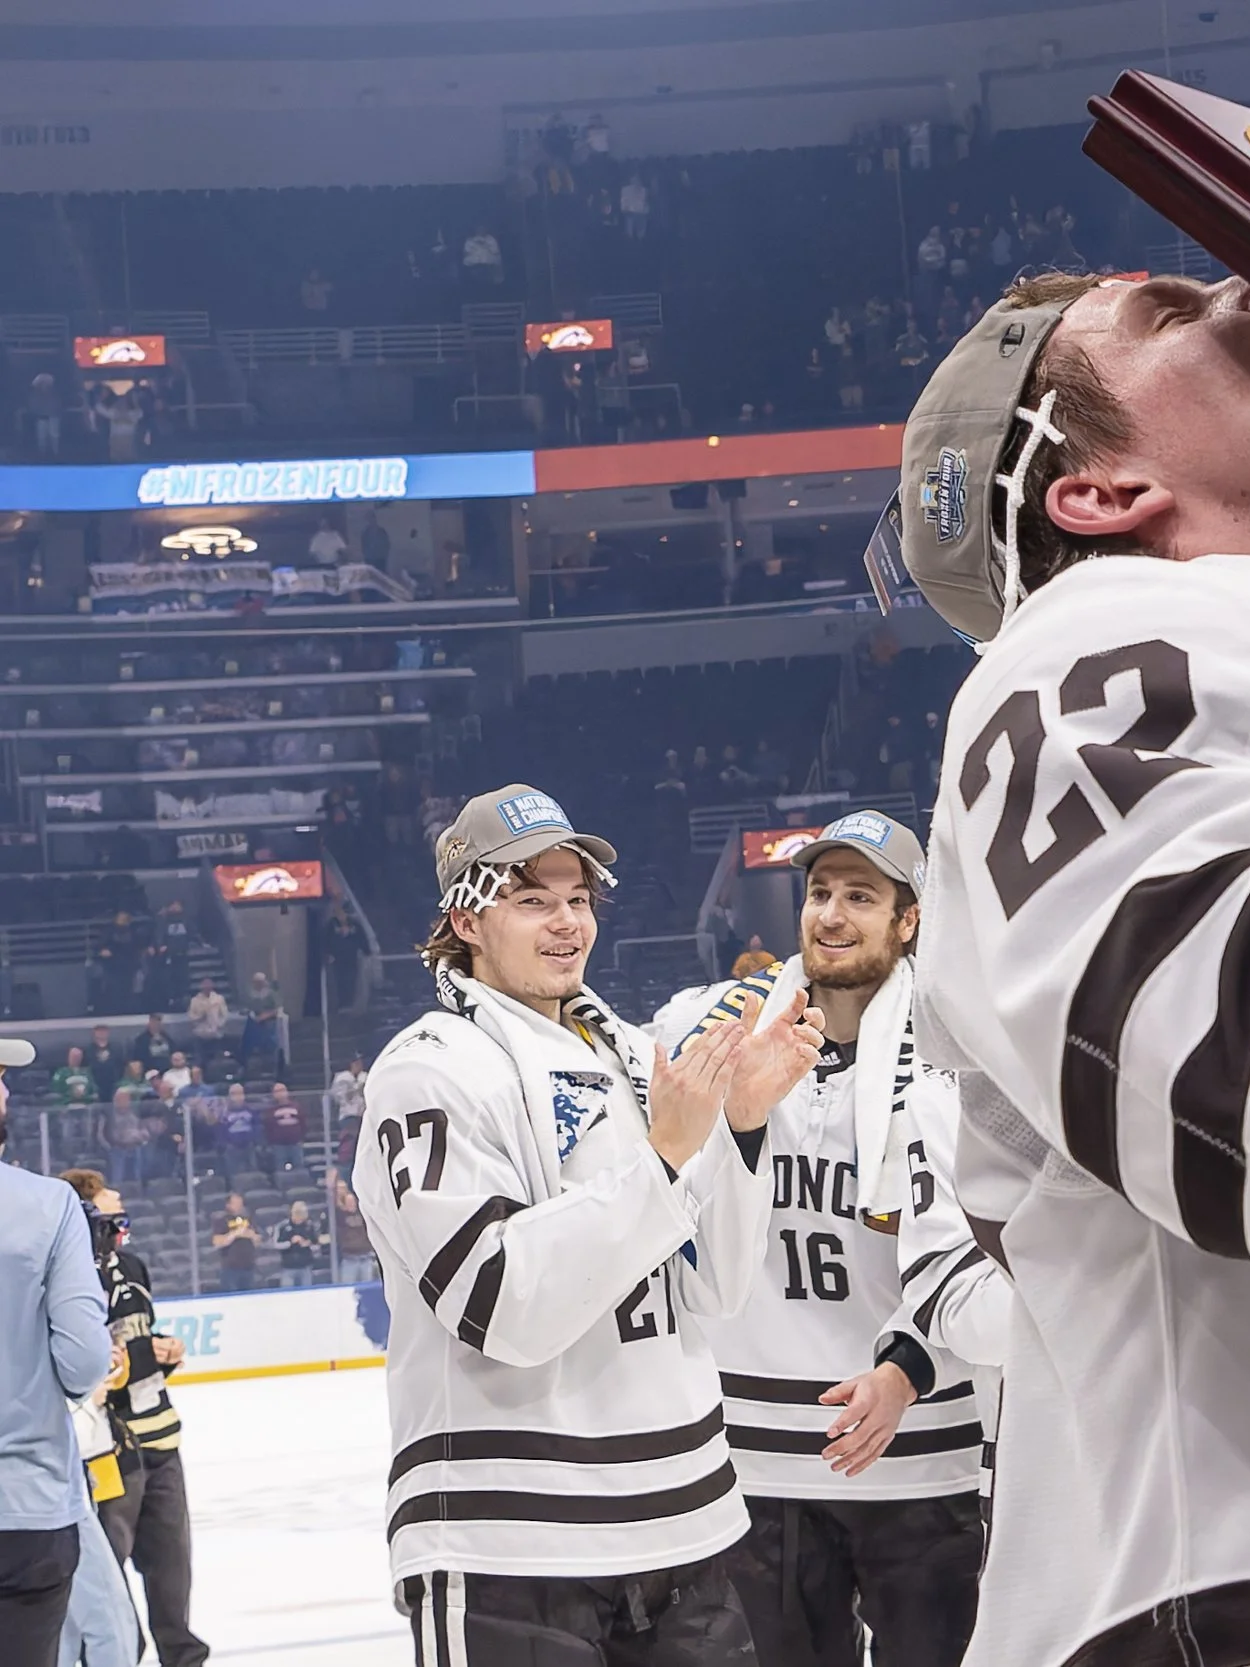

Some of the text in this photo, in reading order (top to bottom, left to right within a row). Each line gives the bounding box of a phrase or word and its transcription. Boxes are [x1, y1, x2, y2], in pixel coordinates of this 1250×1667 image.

[140, 460, 406, 504] #MFROZENFOUR
[959, 639, 1214, 921] 22
[378, 1108, 449, 1211] 27
[779, 1228, 850, 1302] 16
